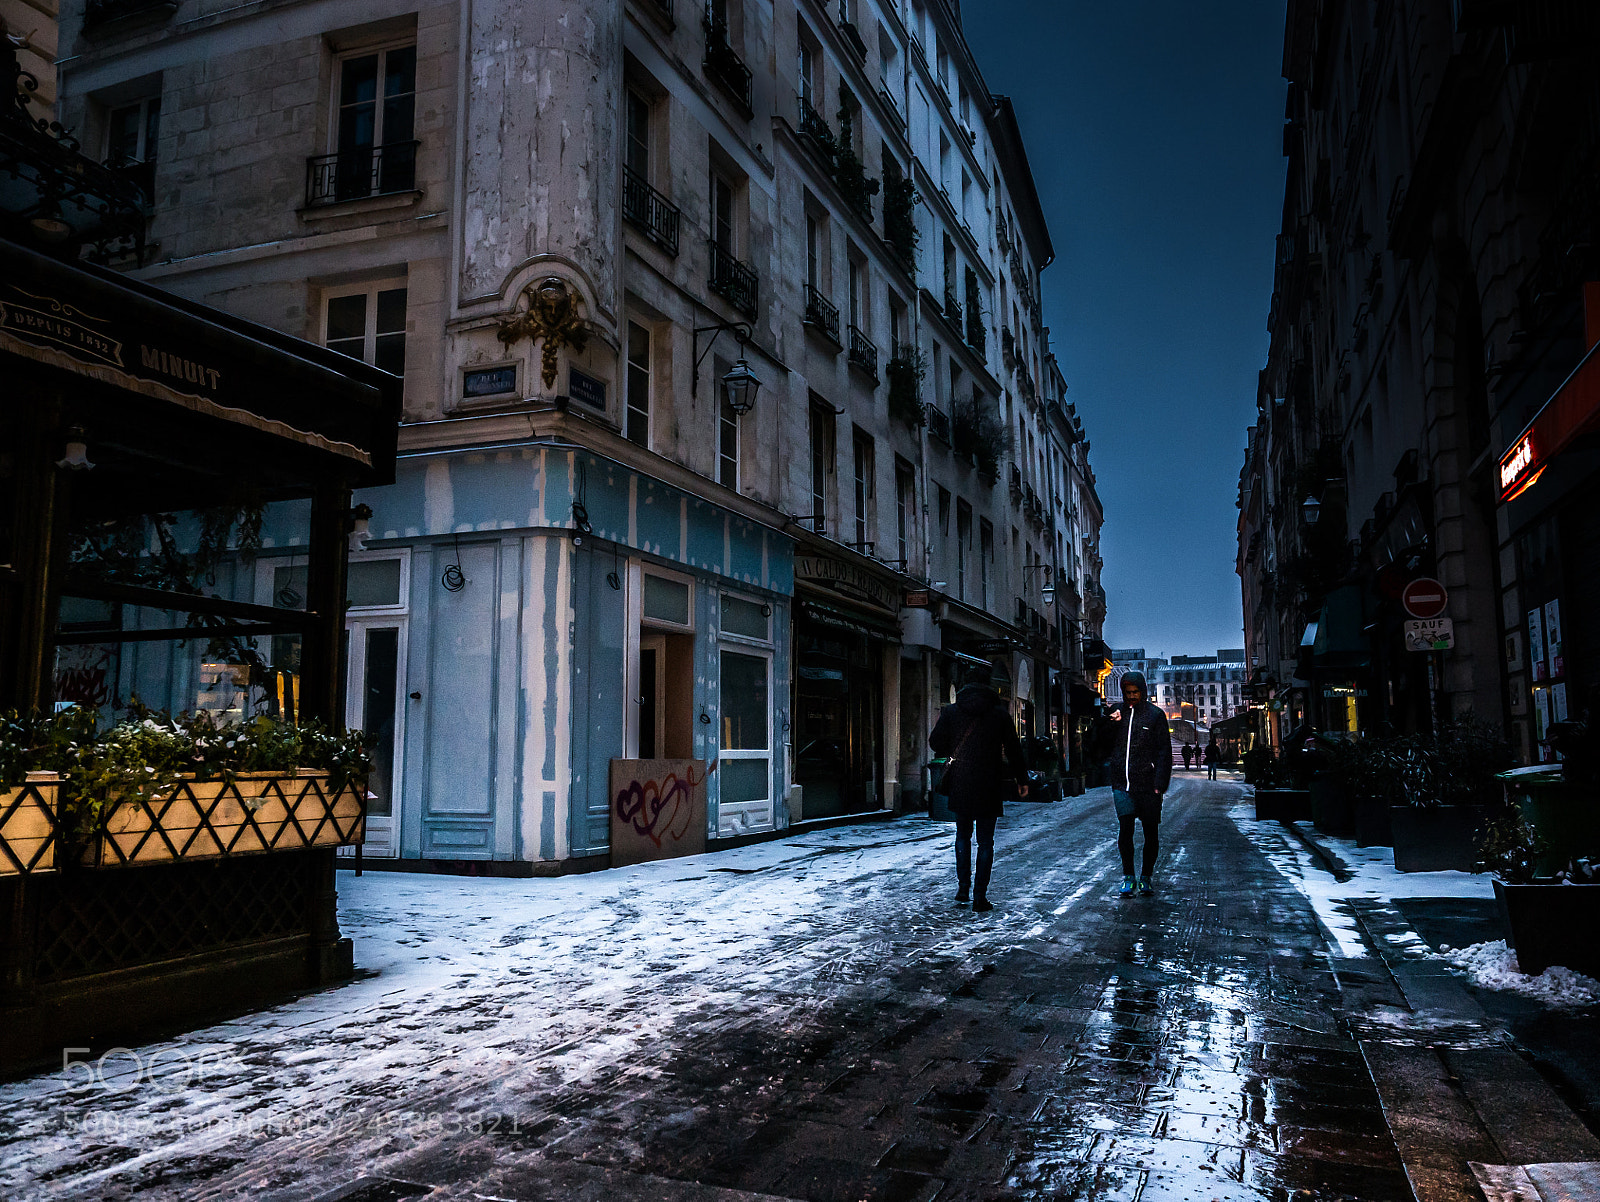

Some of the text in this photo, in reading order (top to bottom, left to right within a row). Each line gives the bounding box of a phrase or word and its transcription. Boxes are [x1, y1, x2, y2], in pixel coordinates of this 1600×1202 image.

[14, 311, 72, 338] DEPUIS
[140, 344, 221, 390] MINUIT
[1412, 620, 1444, 630] SAUF
